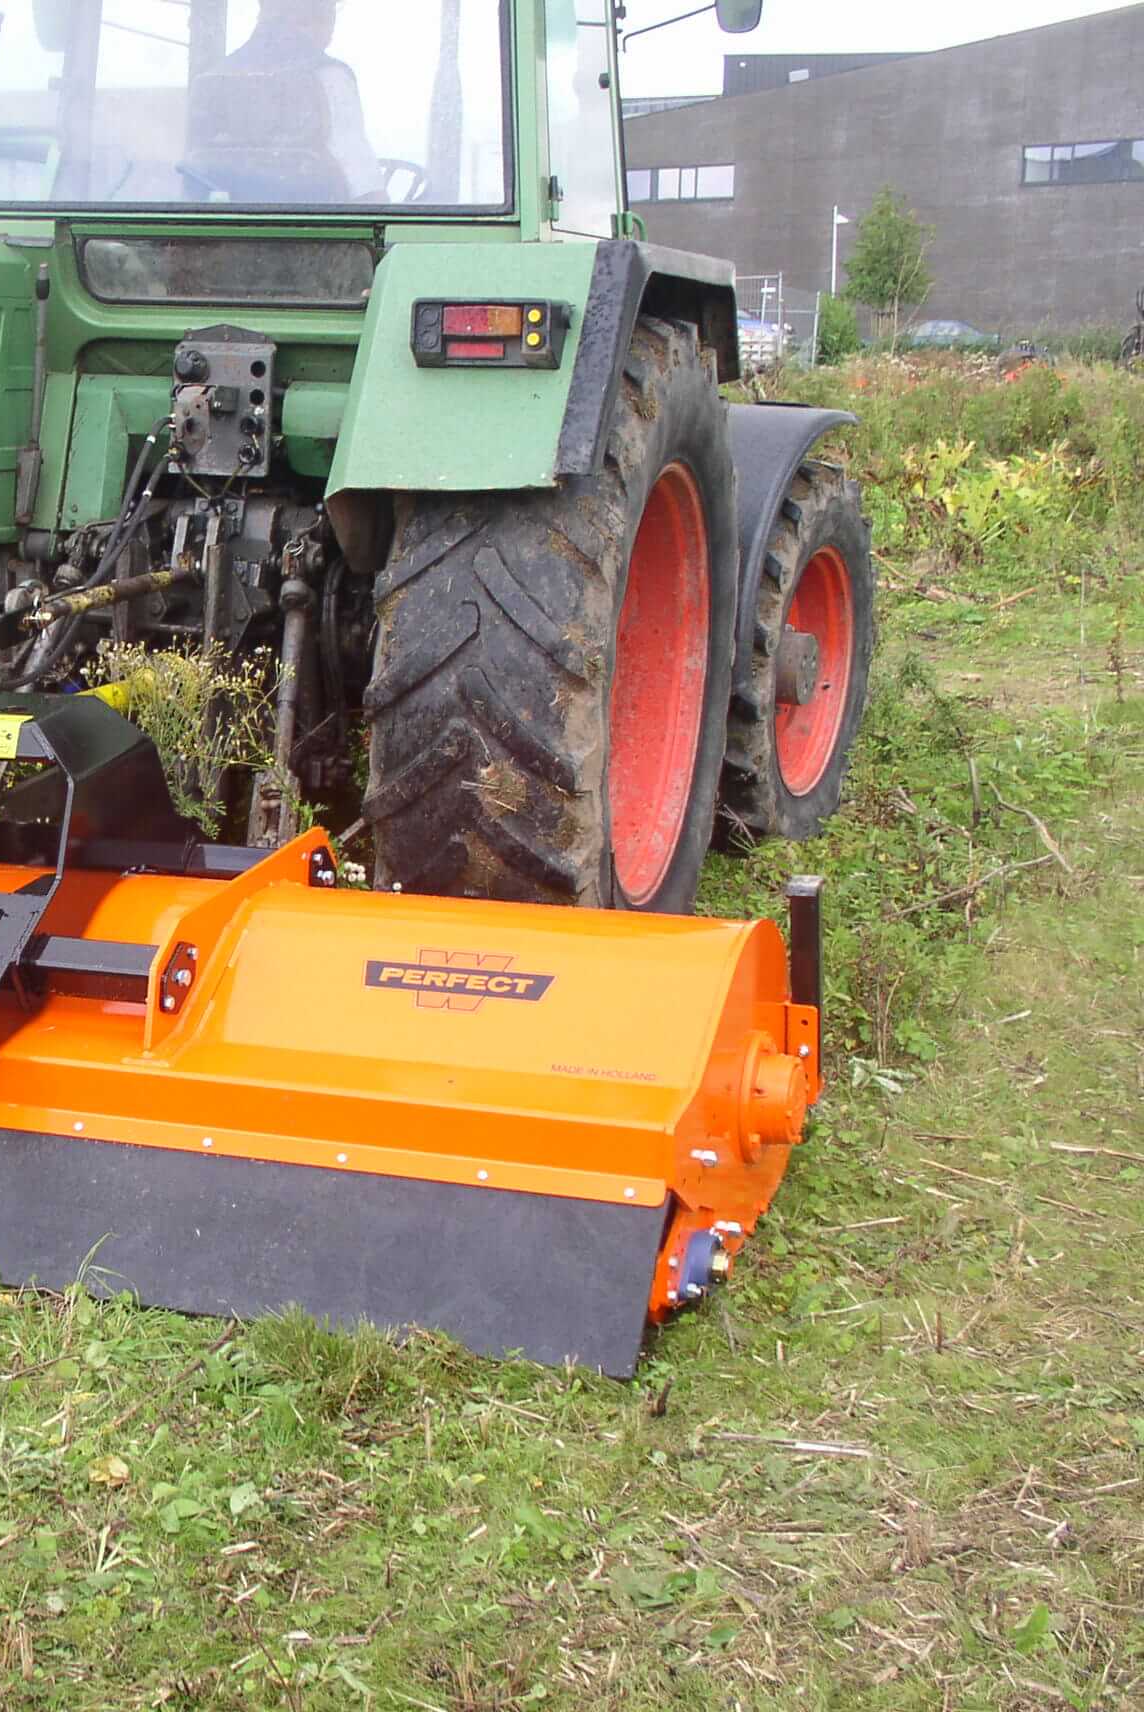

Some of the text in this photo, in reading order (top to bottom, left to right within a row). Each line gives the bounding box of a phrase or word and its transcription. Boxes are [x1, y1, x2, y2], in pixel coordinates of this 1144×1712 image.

[379, 967, 534, 994] PERFECT
[551, 1064, 584, 1074] MADE
[600, 1069, 657, 1081] HOLLAND
